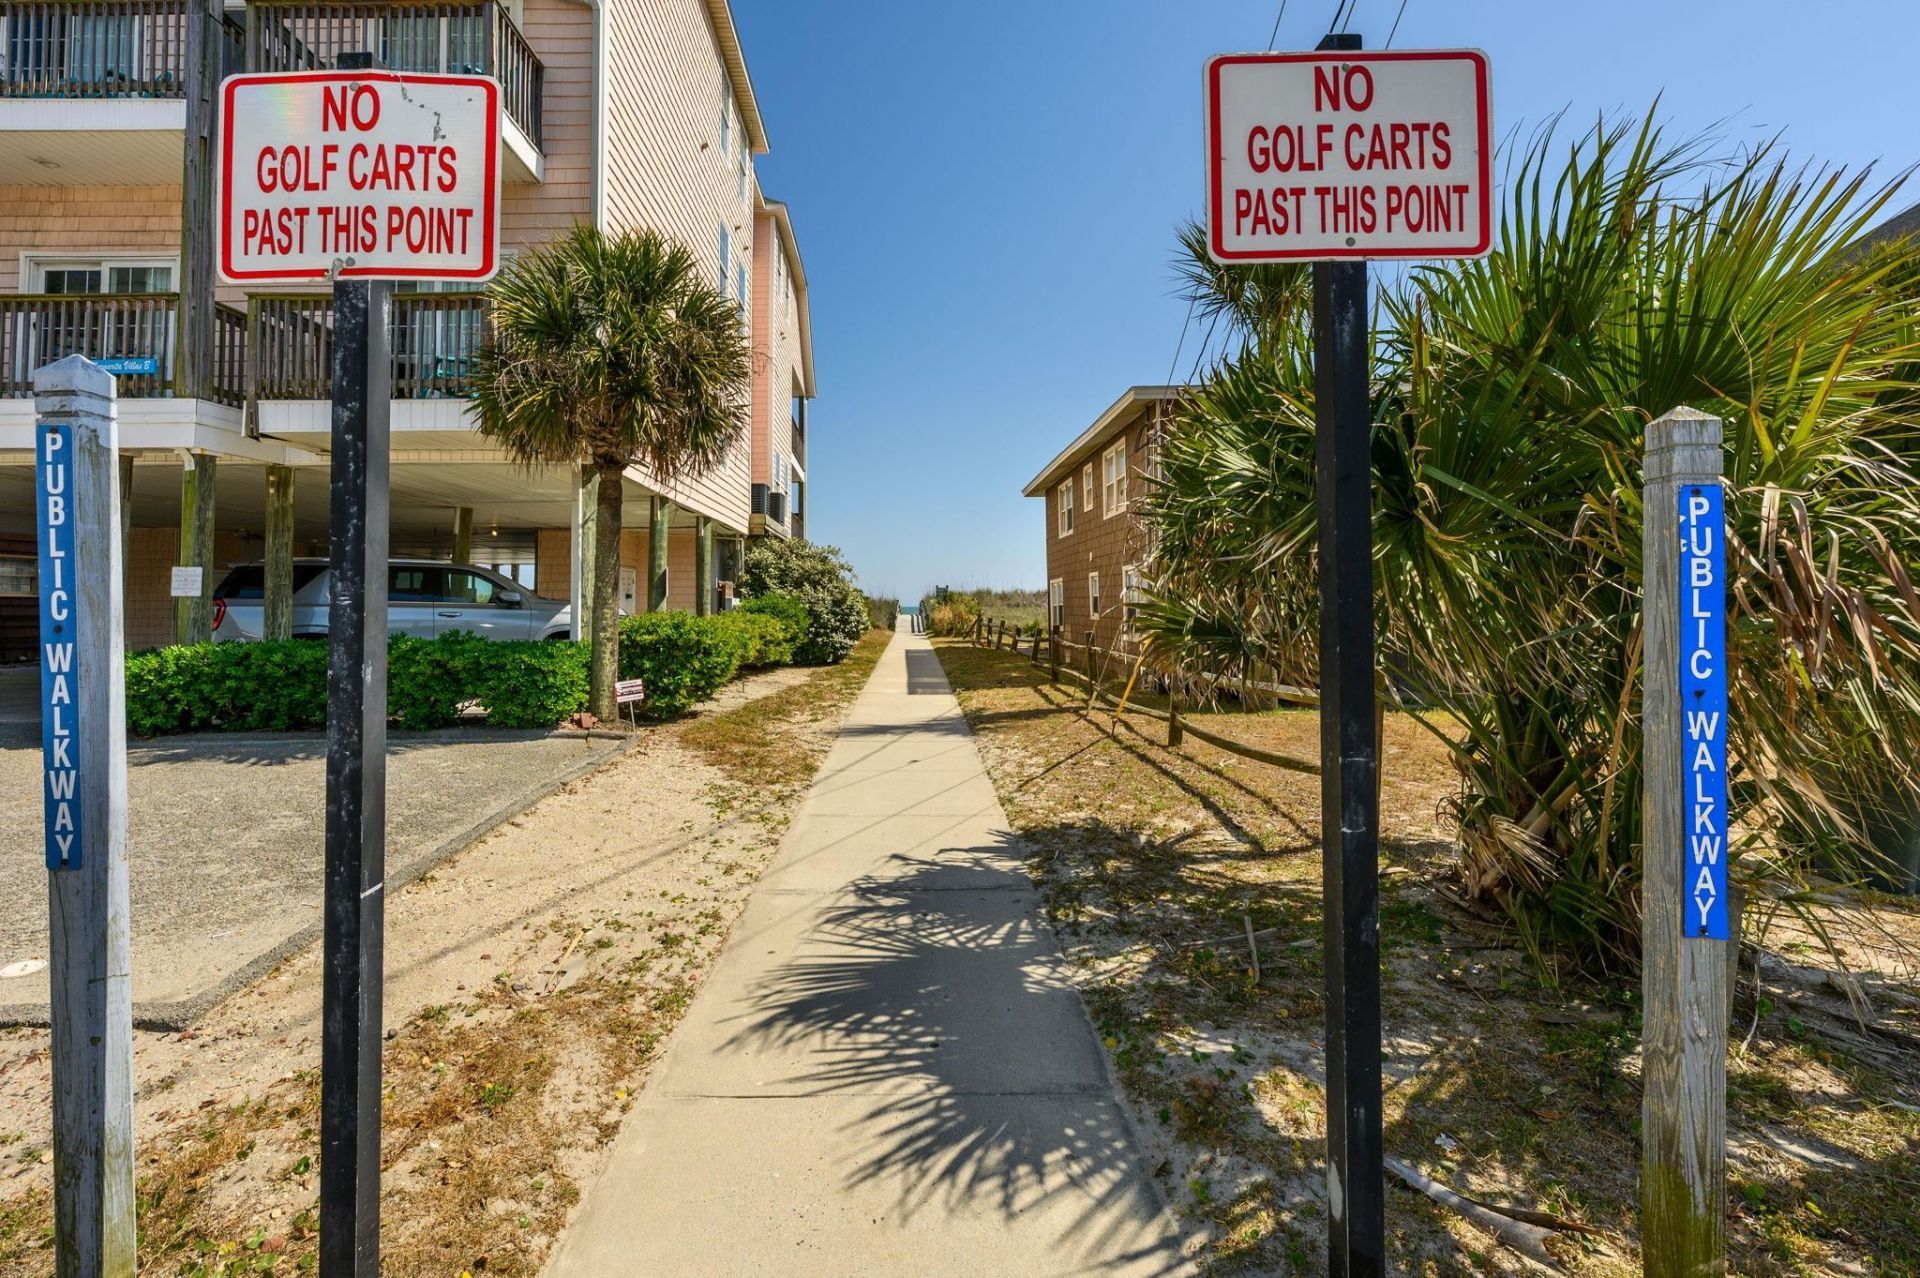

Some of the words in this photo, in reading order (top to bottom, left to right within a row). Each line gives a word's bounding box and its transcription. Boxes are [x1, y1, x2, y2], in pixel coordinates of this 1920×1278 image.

[321, 85, 382, 132] NO
[1314, 65, 1374, 112] NO
[256, 144, 340, 194] GOLF
[348, 143, 458, 193] CARTS
[1247, 124, 1333, 173] GOLF
[1344, 122, 1451, 170] CARTS
[242, 207, 311, 256] PAST
[317, 205, 378, 254] THIS
[386, 206, 475, 255] POINT
[1235, 187, 1307, 236] PAST
[1313, 186, 1377, 234] THIS
[1386, 184, 1469, 234] POINT
[123, 360, 143, 370] Villas
[143, 360, 151, 370] B
[45, 432, 68, 621] PUBLIC
[1689, 496, 1713, 679] PUBLIC
[45, 643, 76, 860] WALKWAY
[1687, 711, 1721, 926] WALKWAY
